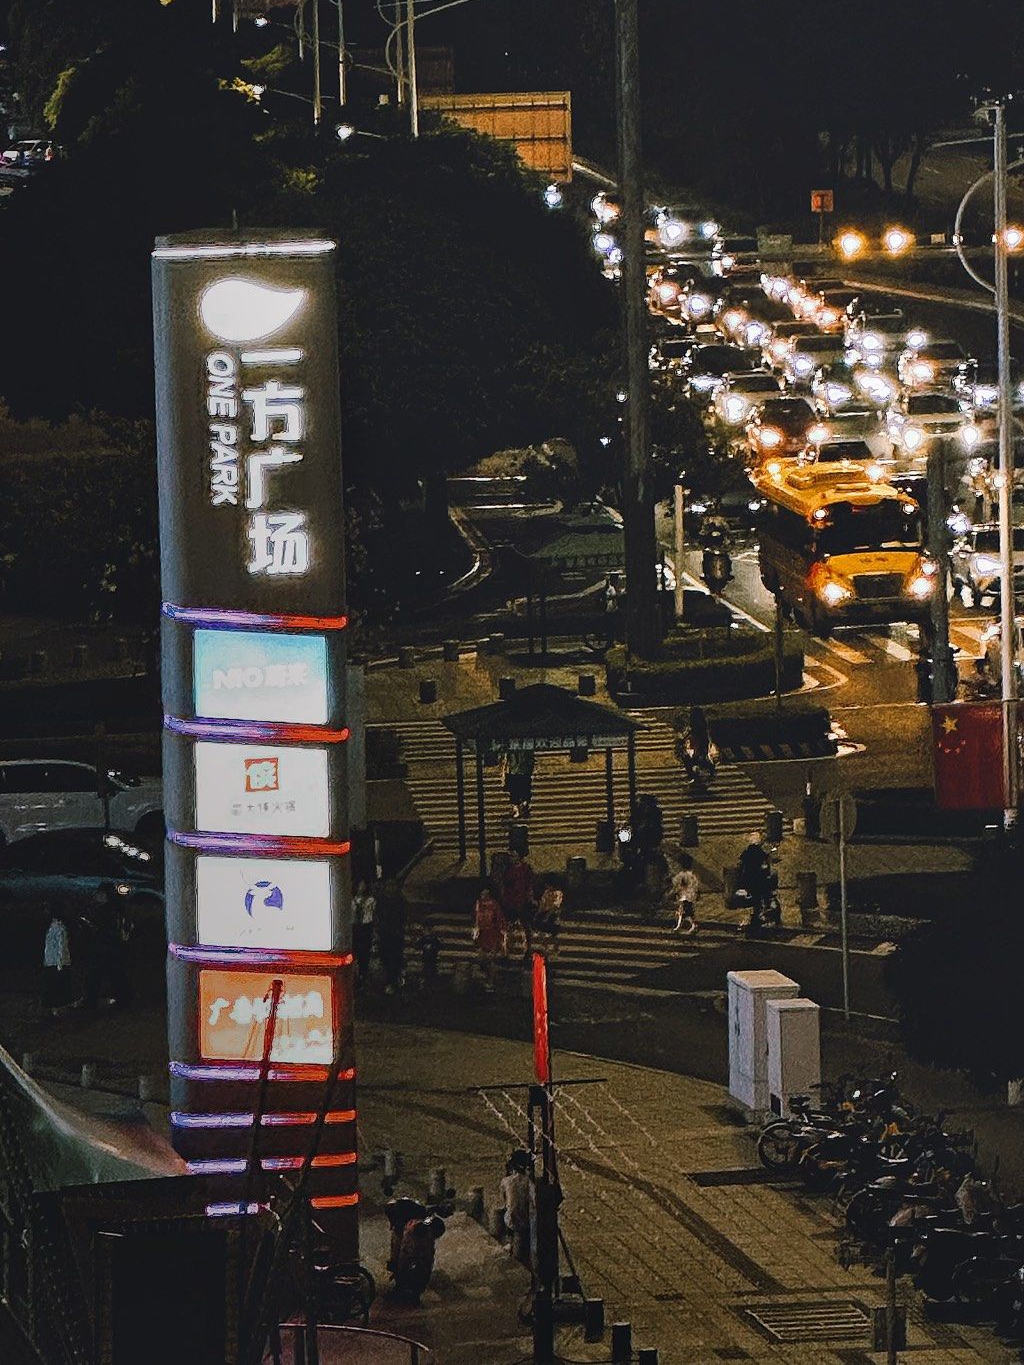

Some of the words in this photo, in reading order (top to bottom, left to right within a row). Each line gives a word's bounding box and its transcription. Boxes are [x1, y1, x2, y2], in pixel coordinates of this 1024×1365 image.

[206, 351, 237, 418] ONE
[208, 423, 238, 507] PARK
[240, 347, 310, 575] 一方广场
[213, 666, 263, 689] NIO
